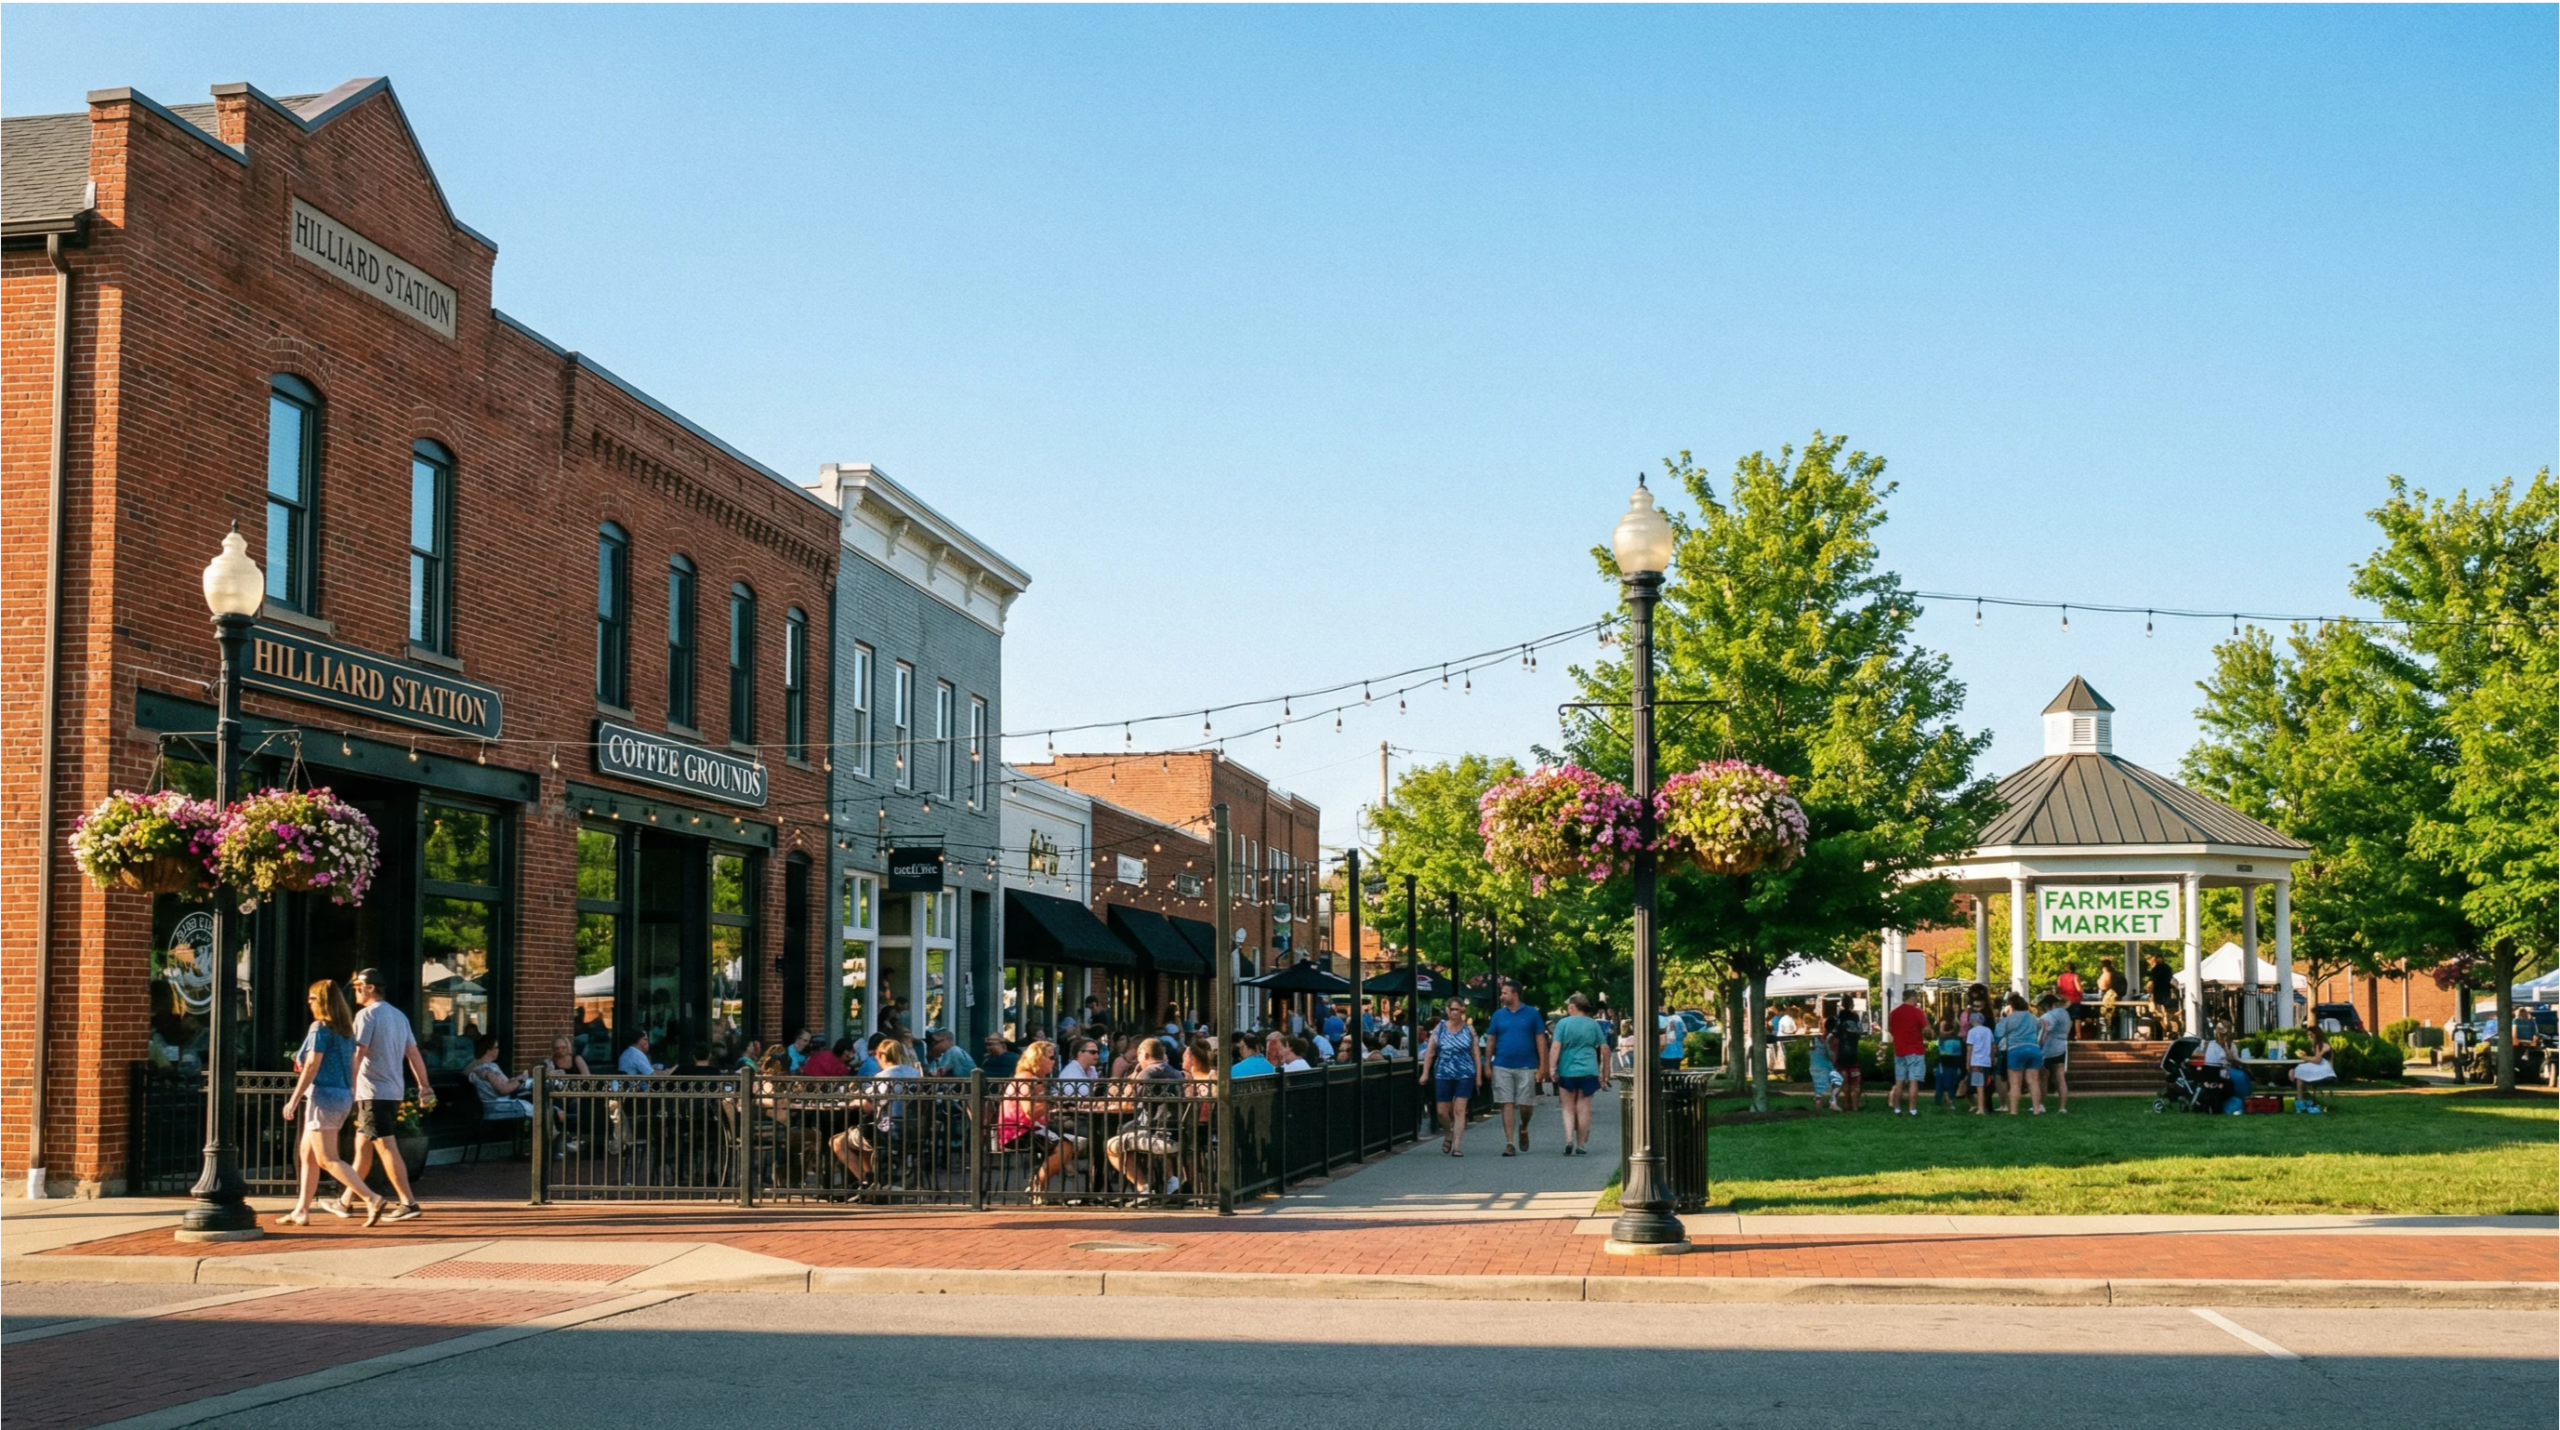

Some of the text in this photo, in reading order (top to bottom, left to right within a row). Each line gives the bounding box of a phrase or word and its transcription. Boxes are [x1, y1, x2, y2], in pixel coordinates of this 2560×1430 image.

[295, 210, 450, 328] HILLIARD STATION
[252, 637, 488, 728] HILLIARD STATION
[609, 734, 761, 797] COFFEE GROUNDS
[2045, 890, 2171, 910] FARMERS
[2052, 914, 2164, 934] MARKET
